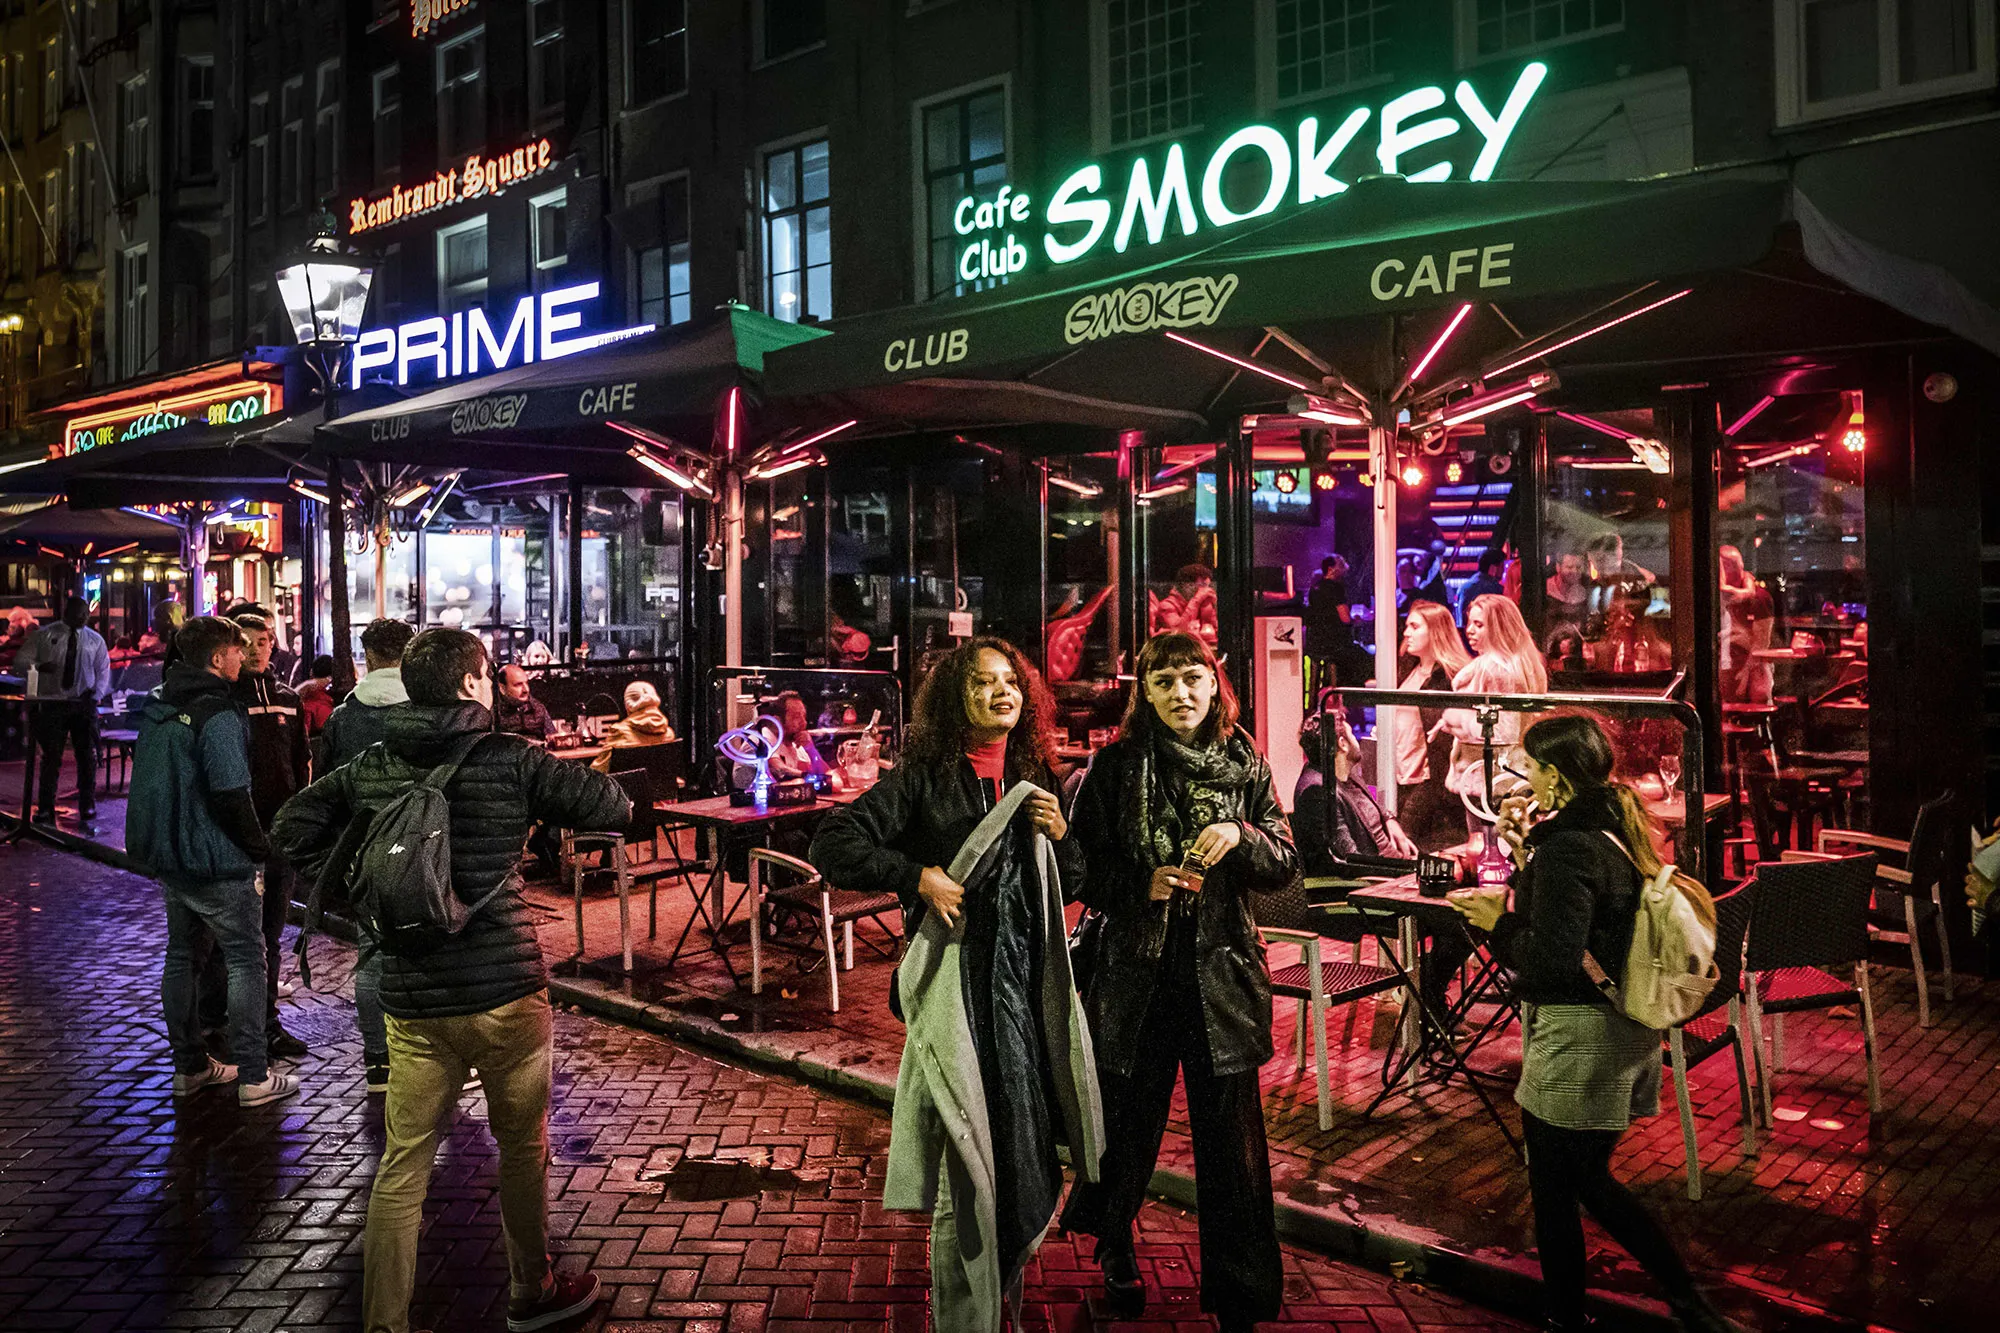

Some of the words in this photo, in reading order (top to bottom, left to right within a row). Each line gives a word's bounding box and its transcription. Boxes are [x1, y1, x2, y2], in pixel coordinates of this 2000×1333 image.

[350, 168, 457, 235] Rembrandt
[463, 138, 551, 197] Square
[954, 185, 1030, 235] Cafe
[1044, 62, 1548, 264] SMOKEY
[960, 234, 1027, 280] Club
[351, 281, 655, 390] PRIME
[885, 329, 969, 372] CLUB
[1065, 273, 1238, 344] SMOKEY
[1371, 243, 1514, 300] CAFE
[371, 414, 410, 442] CLUB
[451, 393, 527, 435] SMOKEY
[579, 383, 637, 416] CAFE
